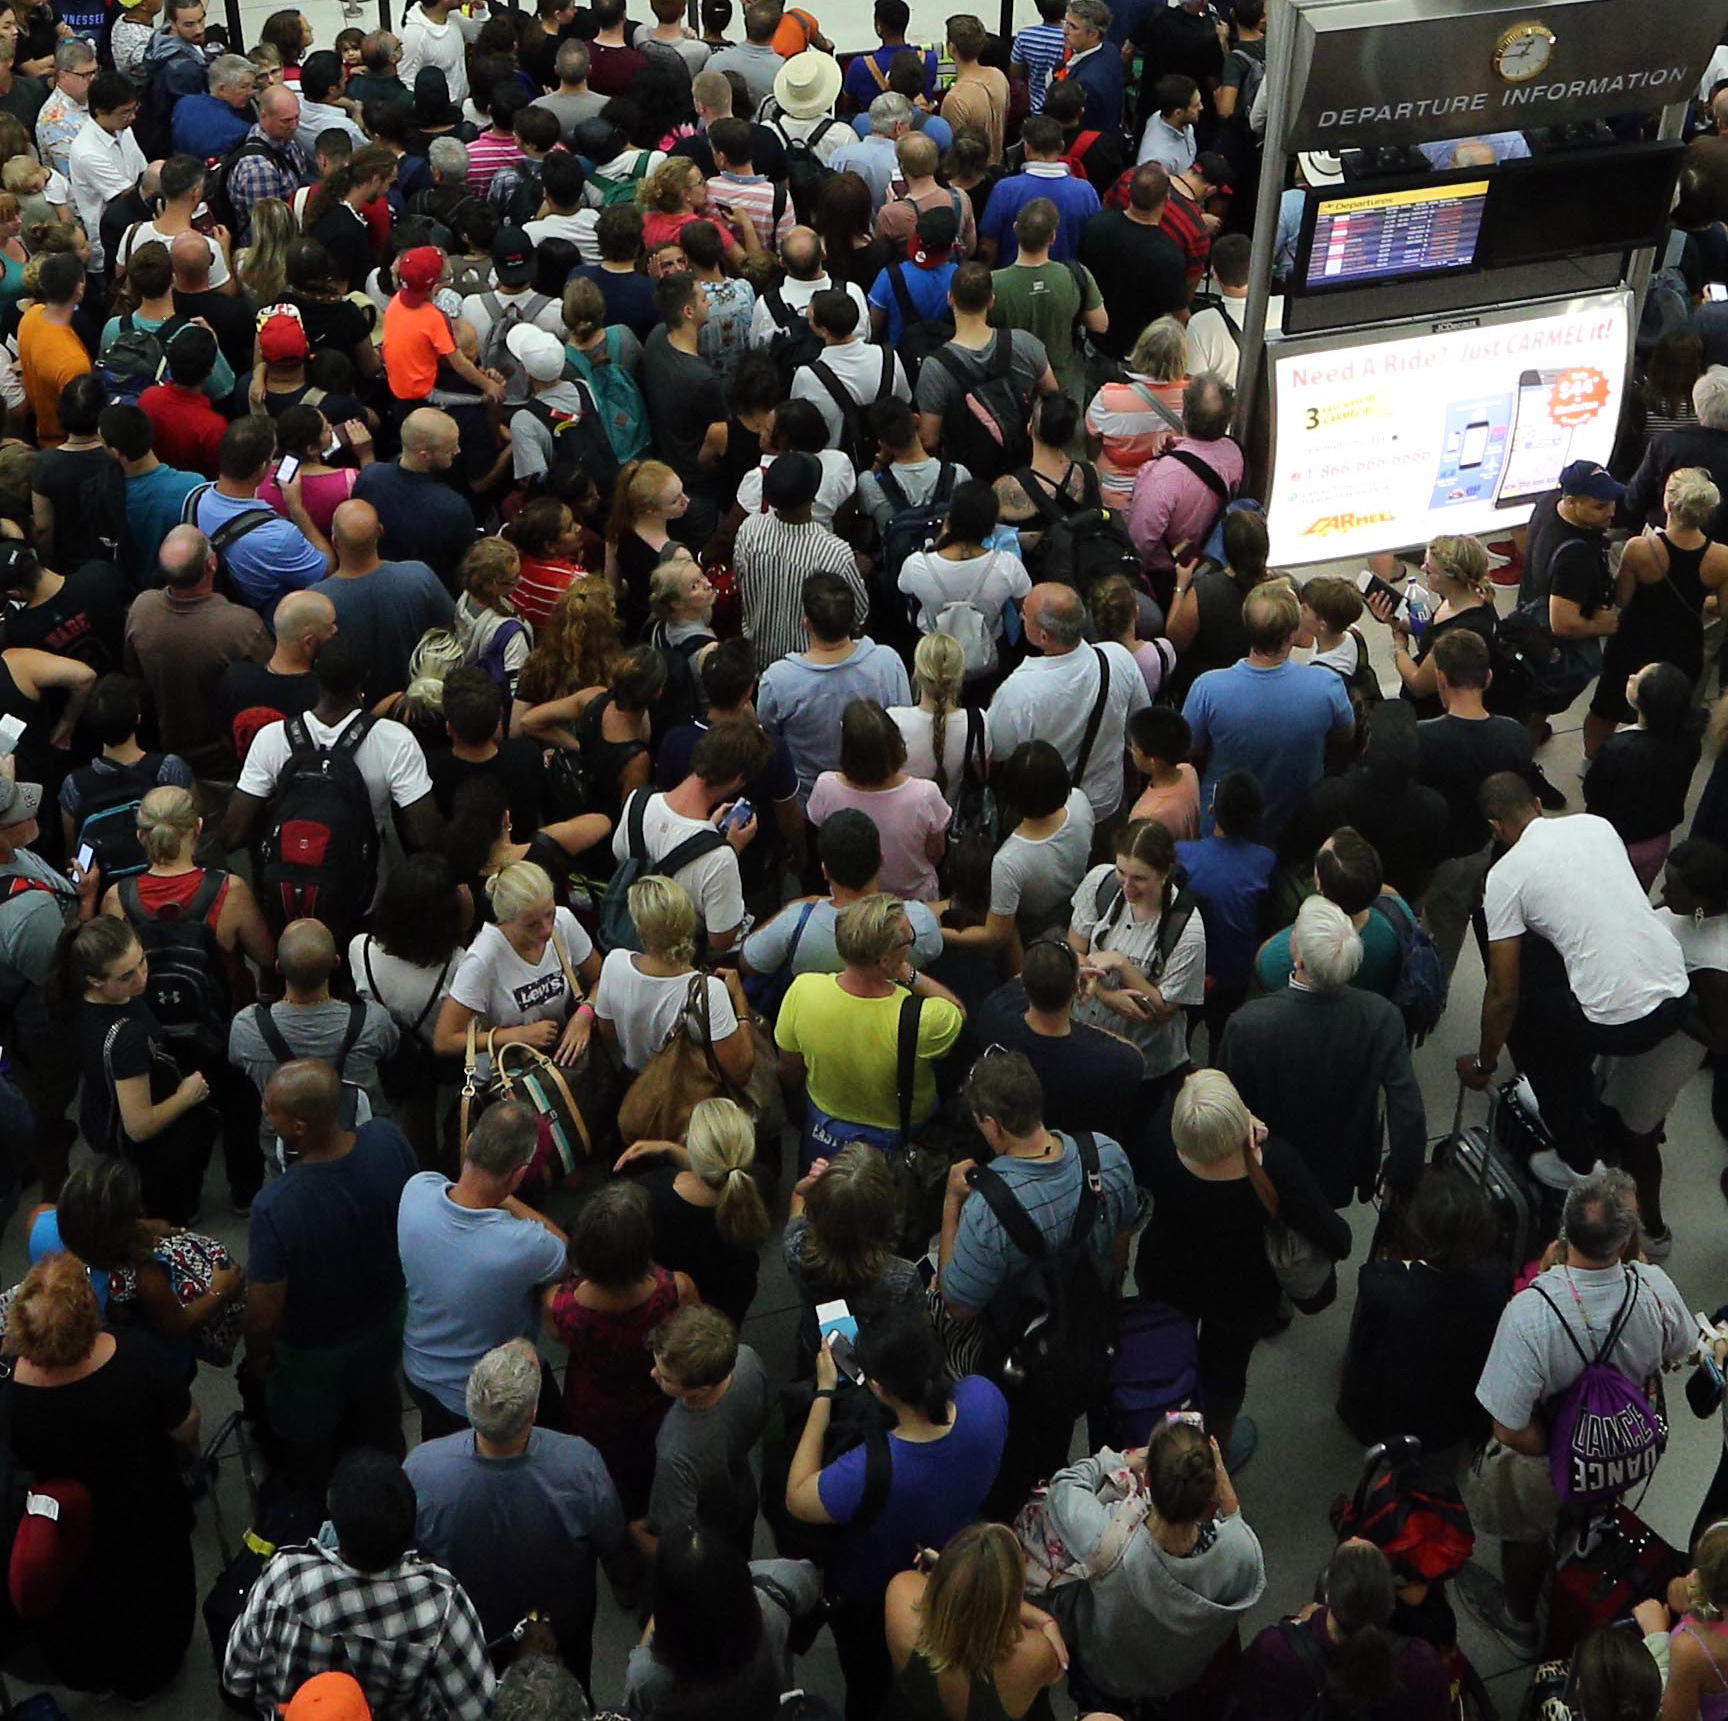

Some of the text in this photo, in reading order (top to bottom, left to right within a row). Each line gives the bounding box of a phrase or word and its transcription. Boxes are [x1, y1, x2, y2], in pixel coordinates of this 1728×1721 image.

[1318, 66, 1689, 128] DEPARTURE INFORMATION
[1335, 197, 1394, 211] Departures
[1292, 318, 1615, 388] Need A Ride? Just CARMEL it!
[1305, 406, 1320, 431] 3
